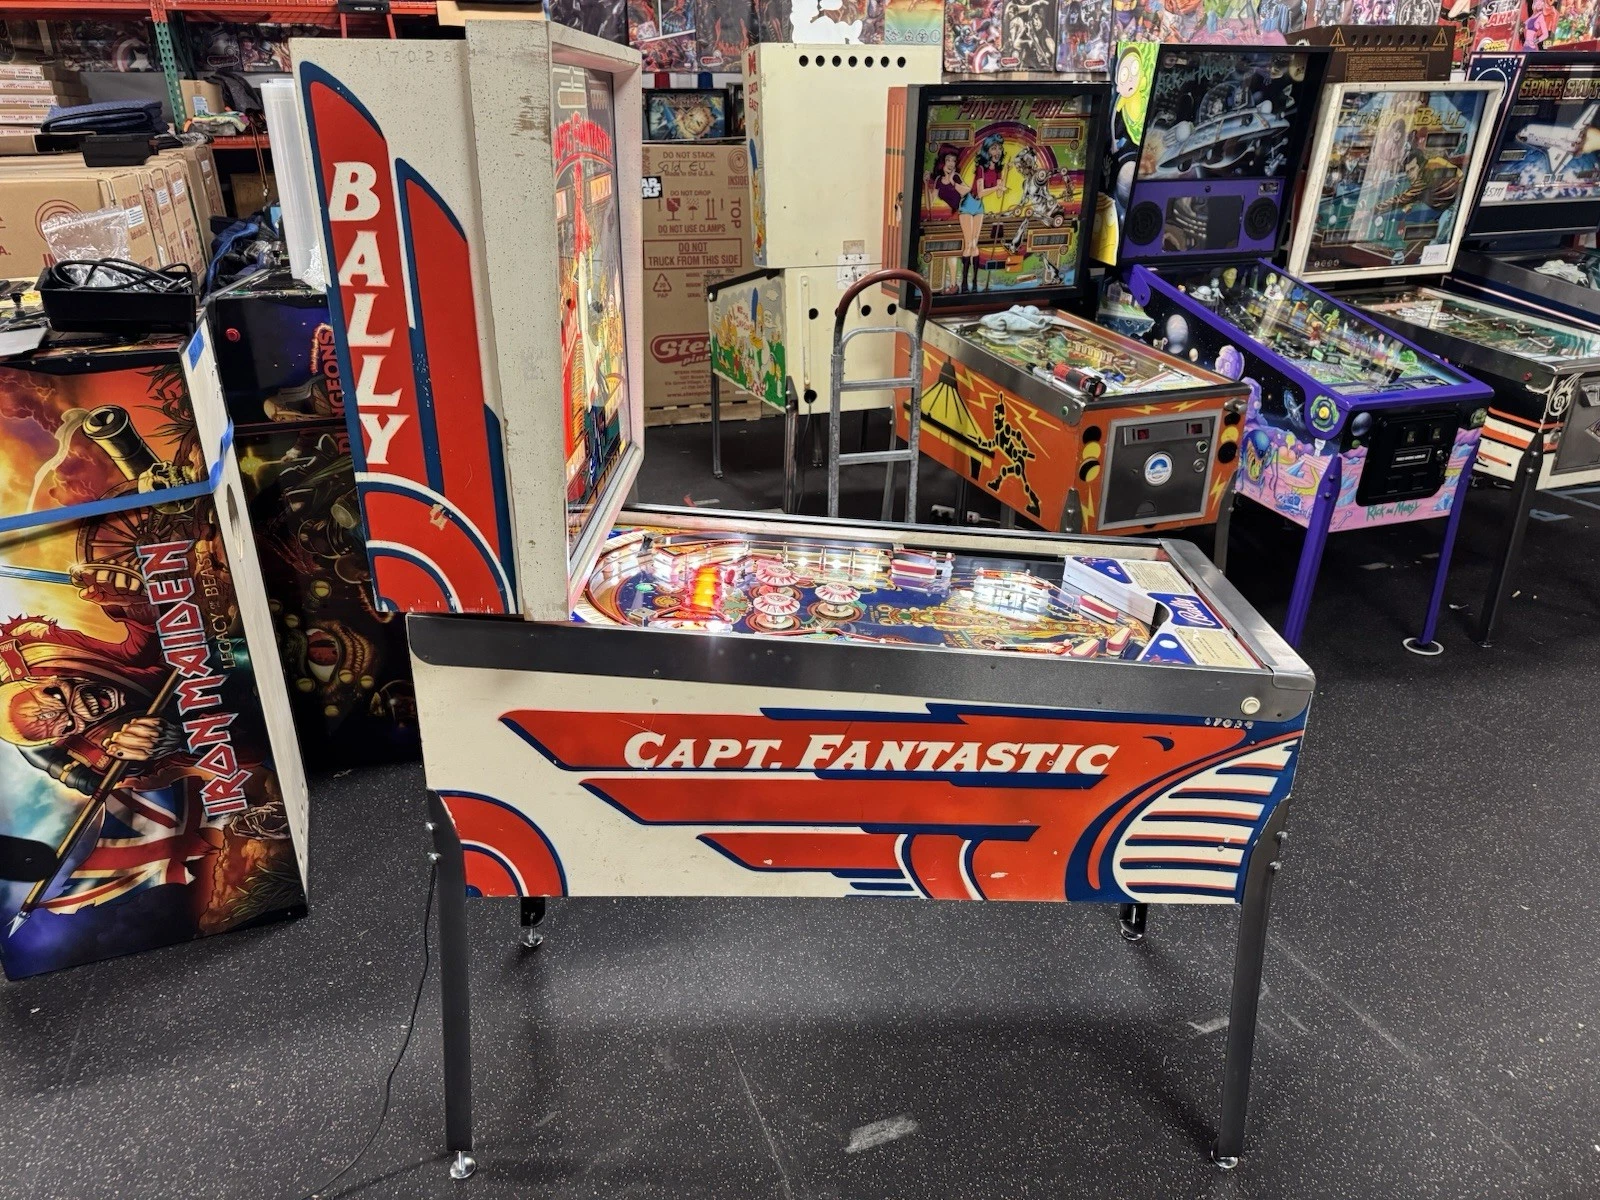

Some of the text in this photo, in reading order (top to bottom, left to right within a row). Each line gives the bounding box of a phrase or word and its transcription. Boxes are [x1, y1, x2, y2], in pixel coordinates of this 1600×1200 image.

[1519, 78, 1562, 100] SPACE
[957, 100, 1026, 120] PINBALL
[1414, 108, 1467, 129] BALL
[642, 178, 660, 188] AR
[643, 186, 661, 198] RS
[730, 197, 742, 228] TOP
[658, 224, 726, 234] DO NOT USE CLAMPS
[679, 242, 708, 252] DO NOT
[648, 254, 738, 266] TRUCK FROM THIS SIDE
[328, 162, 410, 464] BALLY
[660, 339, 710, 358] Ste
[211, 613, 236, 670] LEGACY
[136, 540, 252, 818] IRON MAIDEN
[624, 732, 1120, 774] CAPT. FANTASTIC
